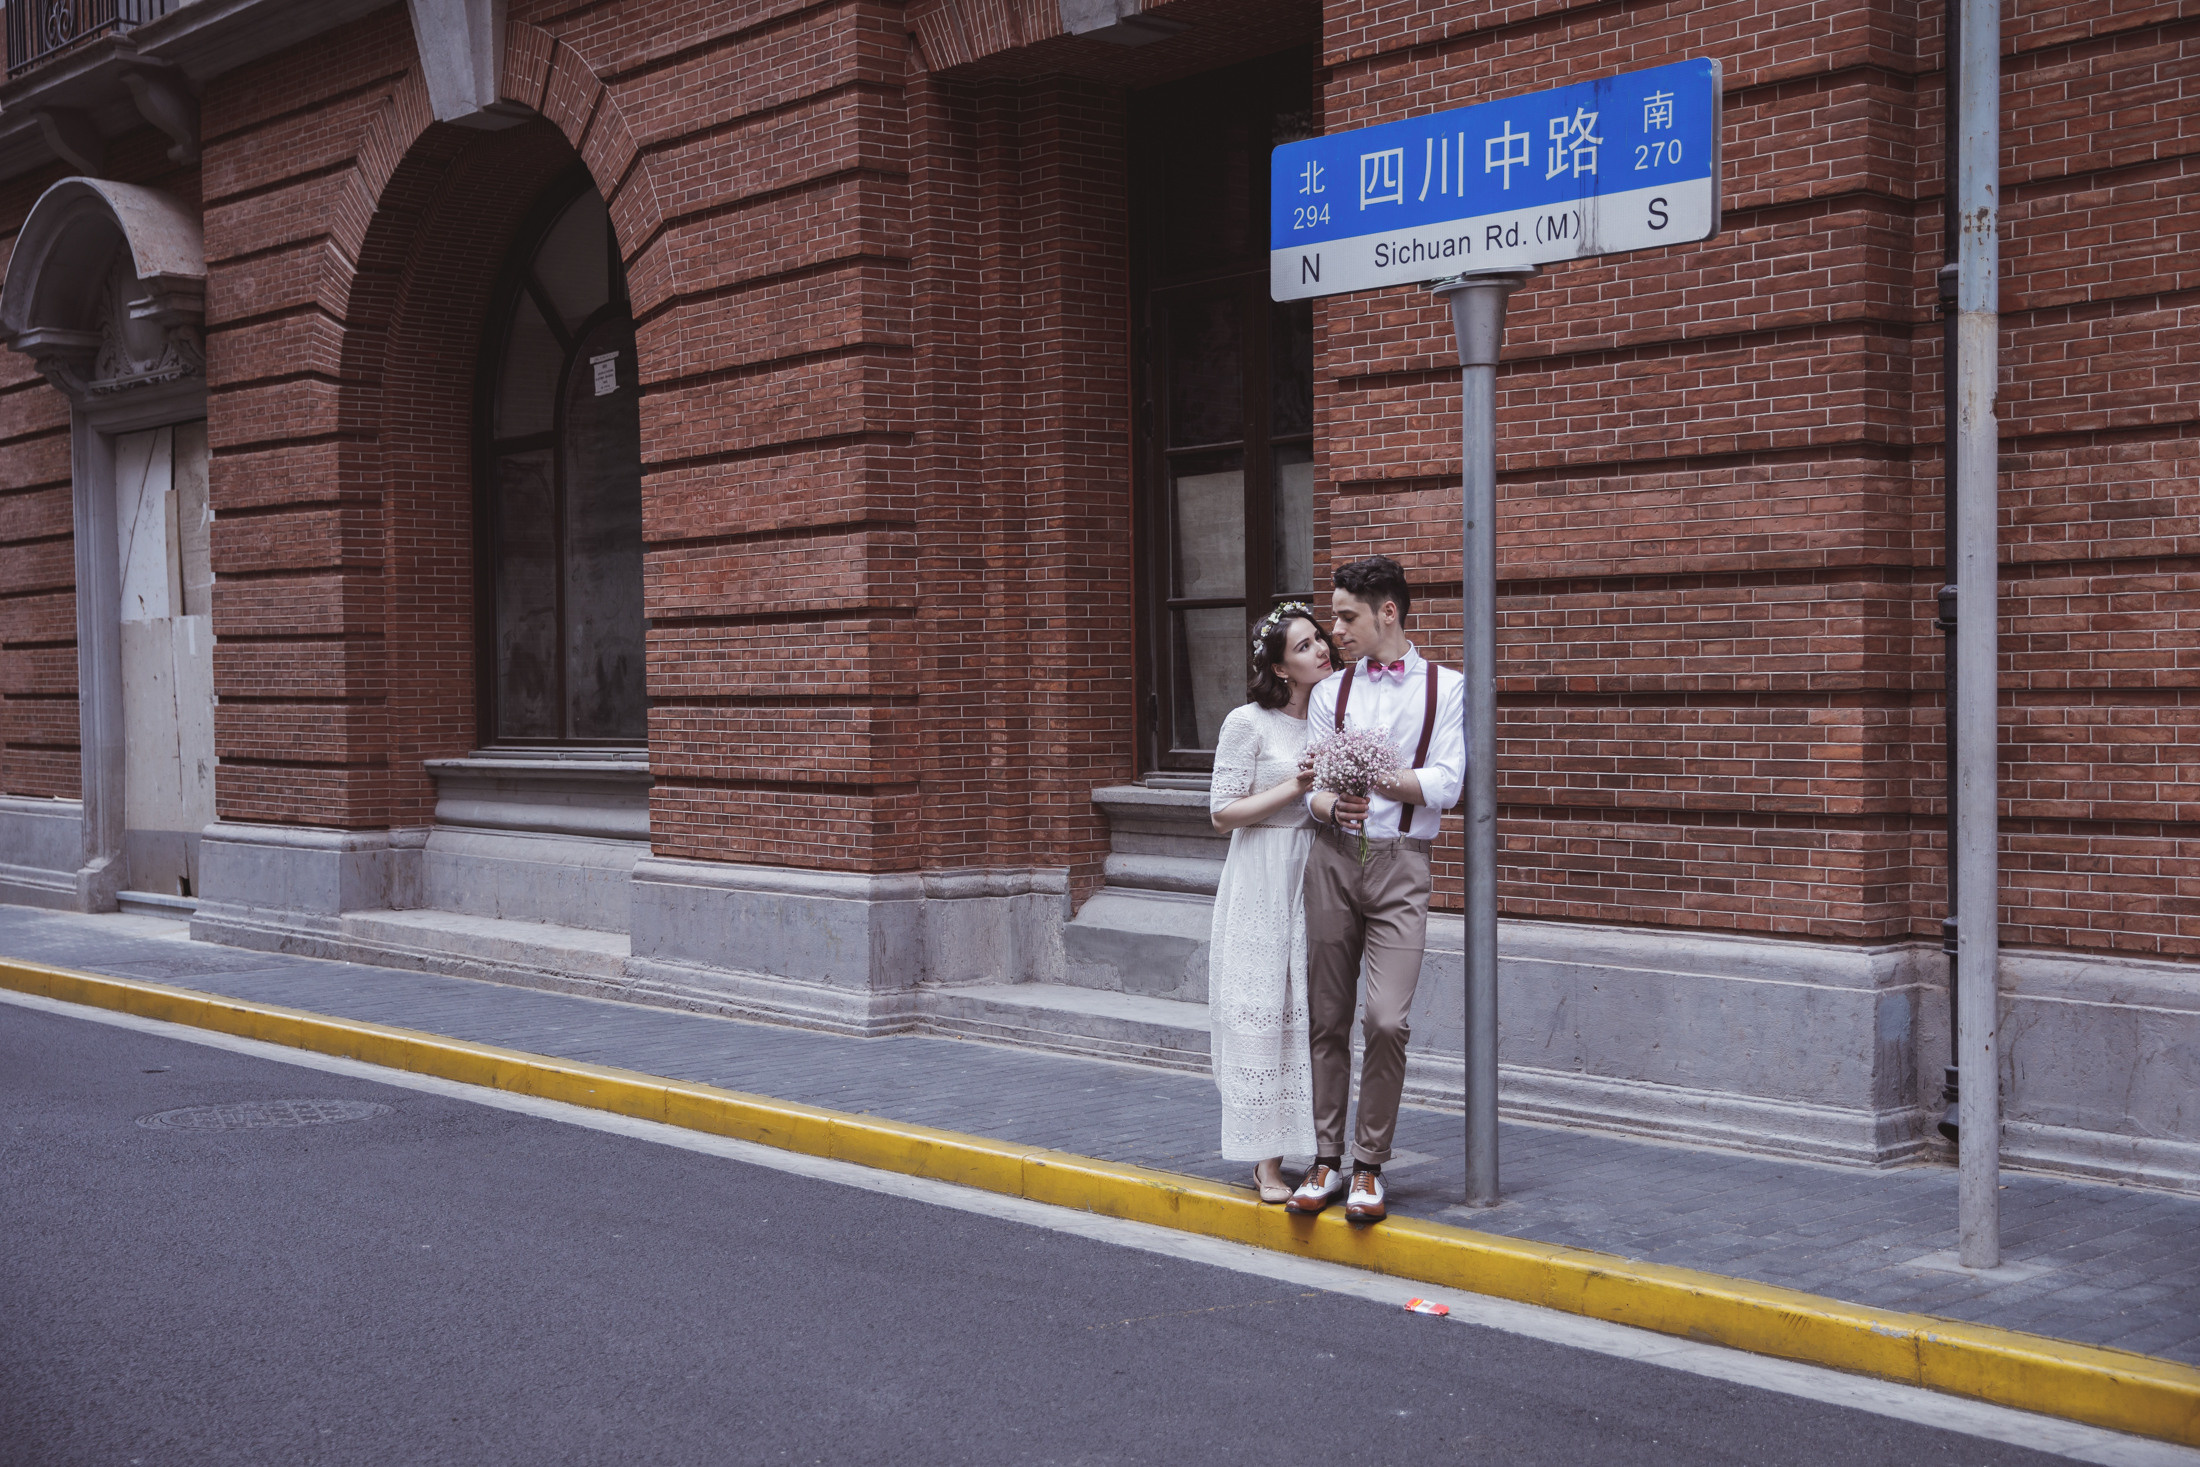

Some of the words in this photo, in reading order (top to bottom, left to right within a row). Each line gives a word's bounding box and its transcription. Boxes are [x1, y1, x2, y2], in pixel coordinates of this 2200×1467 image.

[1643, 89, 1675, 134] 南
[1359, 107, 1604, 212] 四川中路
[1634, 138, 1683, 171] 270
[1299, 160, 1325, 196] 北
[1293, 202, 1331, 231] 294
[1646, 196, 1669, 231] S
[1375, 235, 1472, 268] Sichuan
[1301, 253, 1321, 285] N
